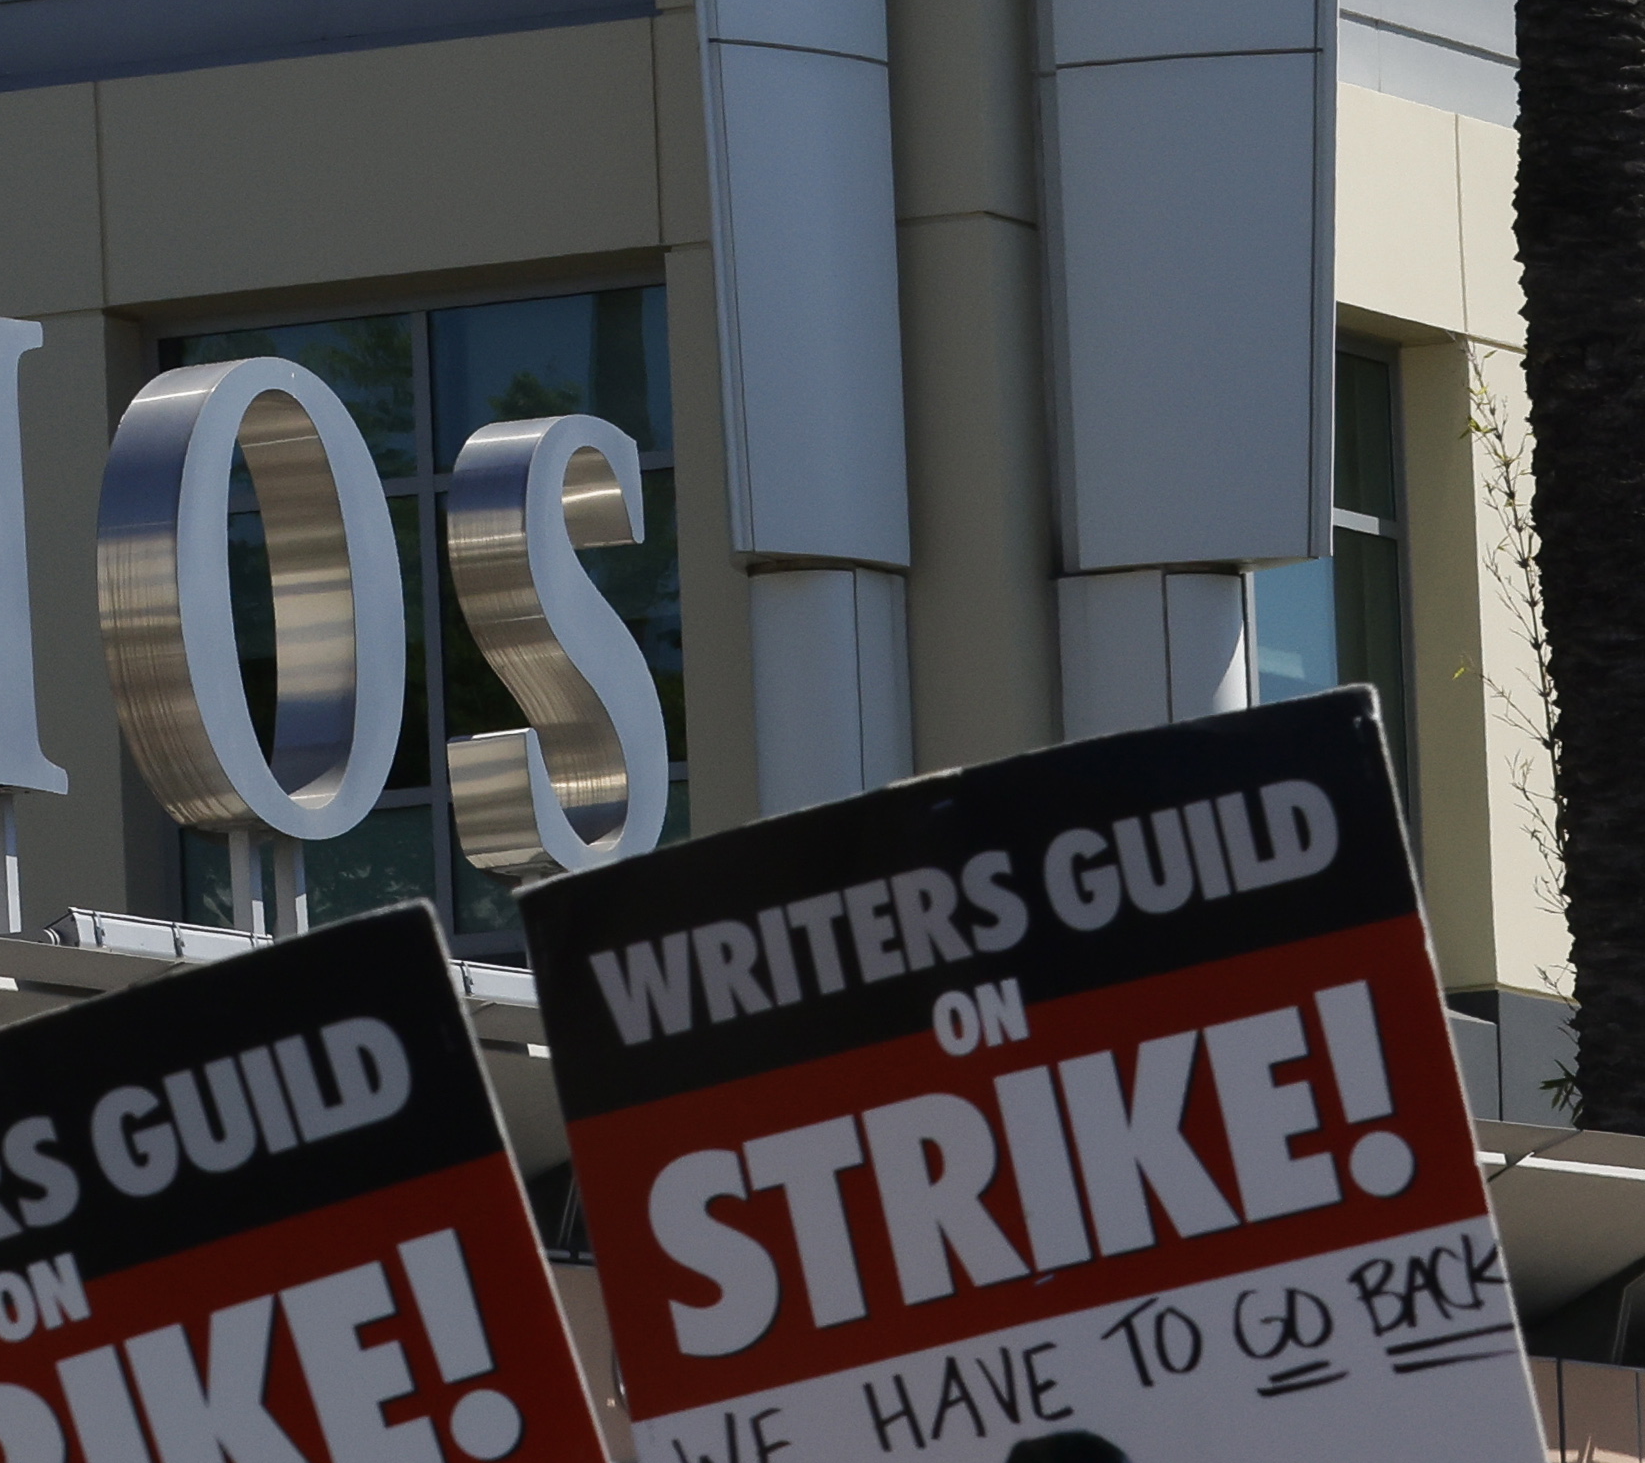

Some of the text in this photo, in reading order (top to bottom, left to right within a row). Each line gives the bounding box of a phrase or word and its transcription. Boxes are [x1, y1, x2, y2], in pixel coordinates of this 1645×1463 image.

[589, 778, 1339, 1047] WRITERS GUILD
[932, 976, 1029, 1056] ON
[90, 1016, 412, 1201] GUILD
[647, 978, 1414, 1359] STRIKE!
[864, 1342, 1075, 1451] HAVE
[1102, 1295, 1202, 1386] TO
[1233, 1287, 1334, 1361] GO
[1349, 1233, 1506, 1335] BACK
